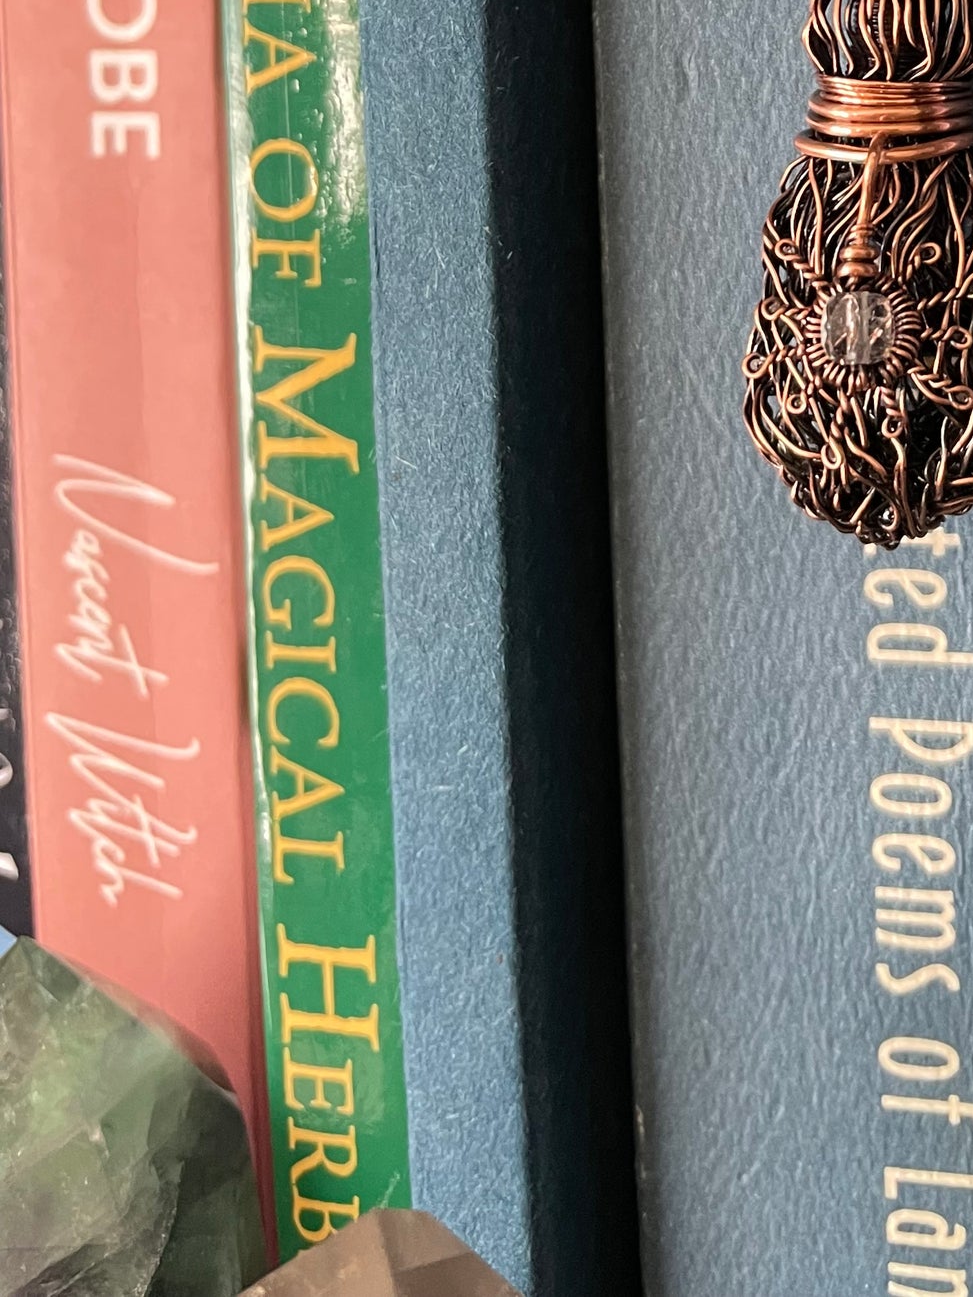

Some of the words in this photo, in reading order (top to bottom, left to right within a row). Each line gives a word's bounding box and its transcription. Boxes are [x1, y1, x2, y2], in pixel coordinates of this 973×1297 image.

[248, 137, 322, 288] OF
[51, 453, 219, 699] Nascent
[252, 324, 360, 886] MAGICAL
[45, 710, 200, 907] Witch
